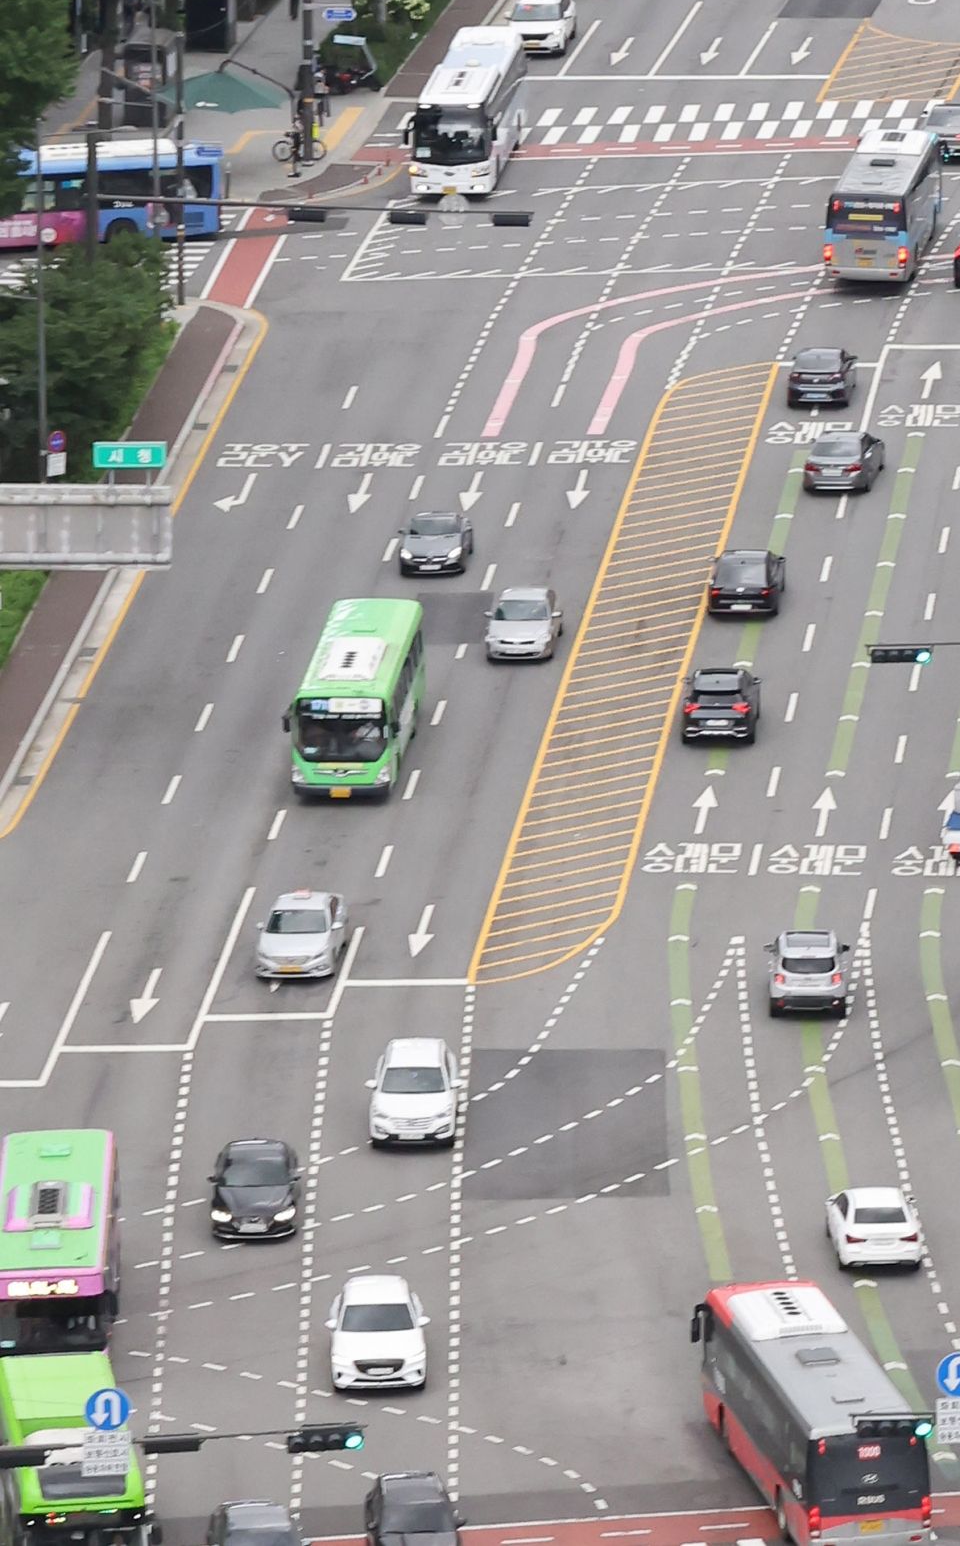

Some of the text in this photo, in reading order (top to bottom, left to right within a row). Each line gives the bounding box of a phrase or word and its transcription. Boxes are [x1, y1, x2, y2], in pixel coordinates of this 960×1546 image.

[216, 443, 311, 468] 소공로
[331, 443, 422, 468] 광화문
[437, 441, 529, 467] 광화문
[547, 439, 638, 464] 광화문
[640, 842, 743, 874] 숭례문
[766, 843, 868, 876] 숭례문
